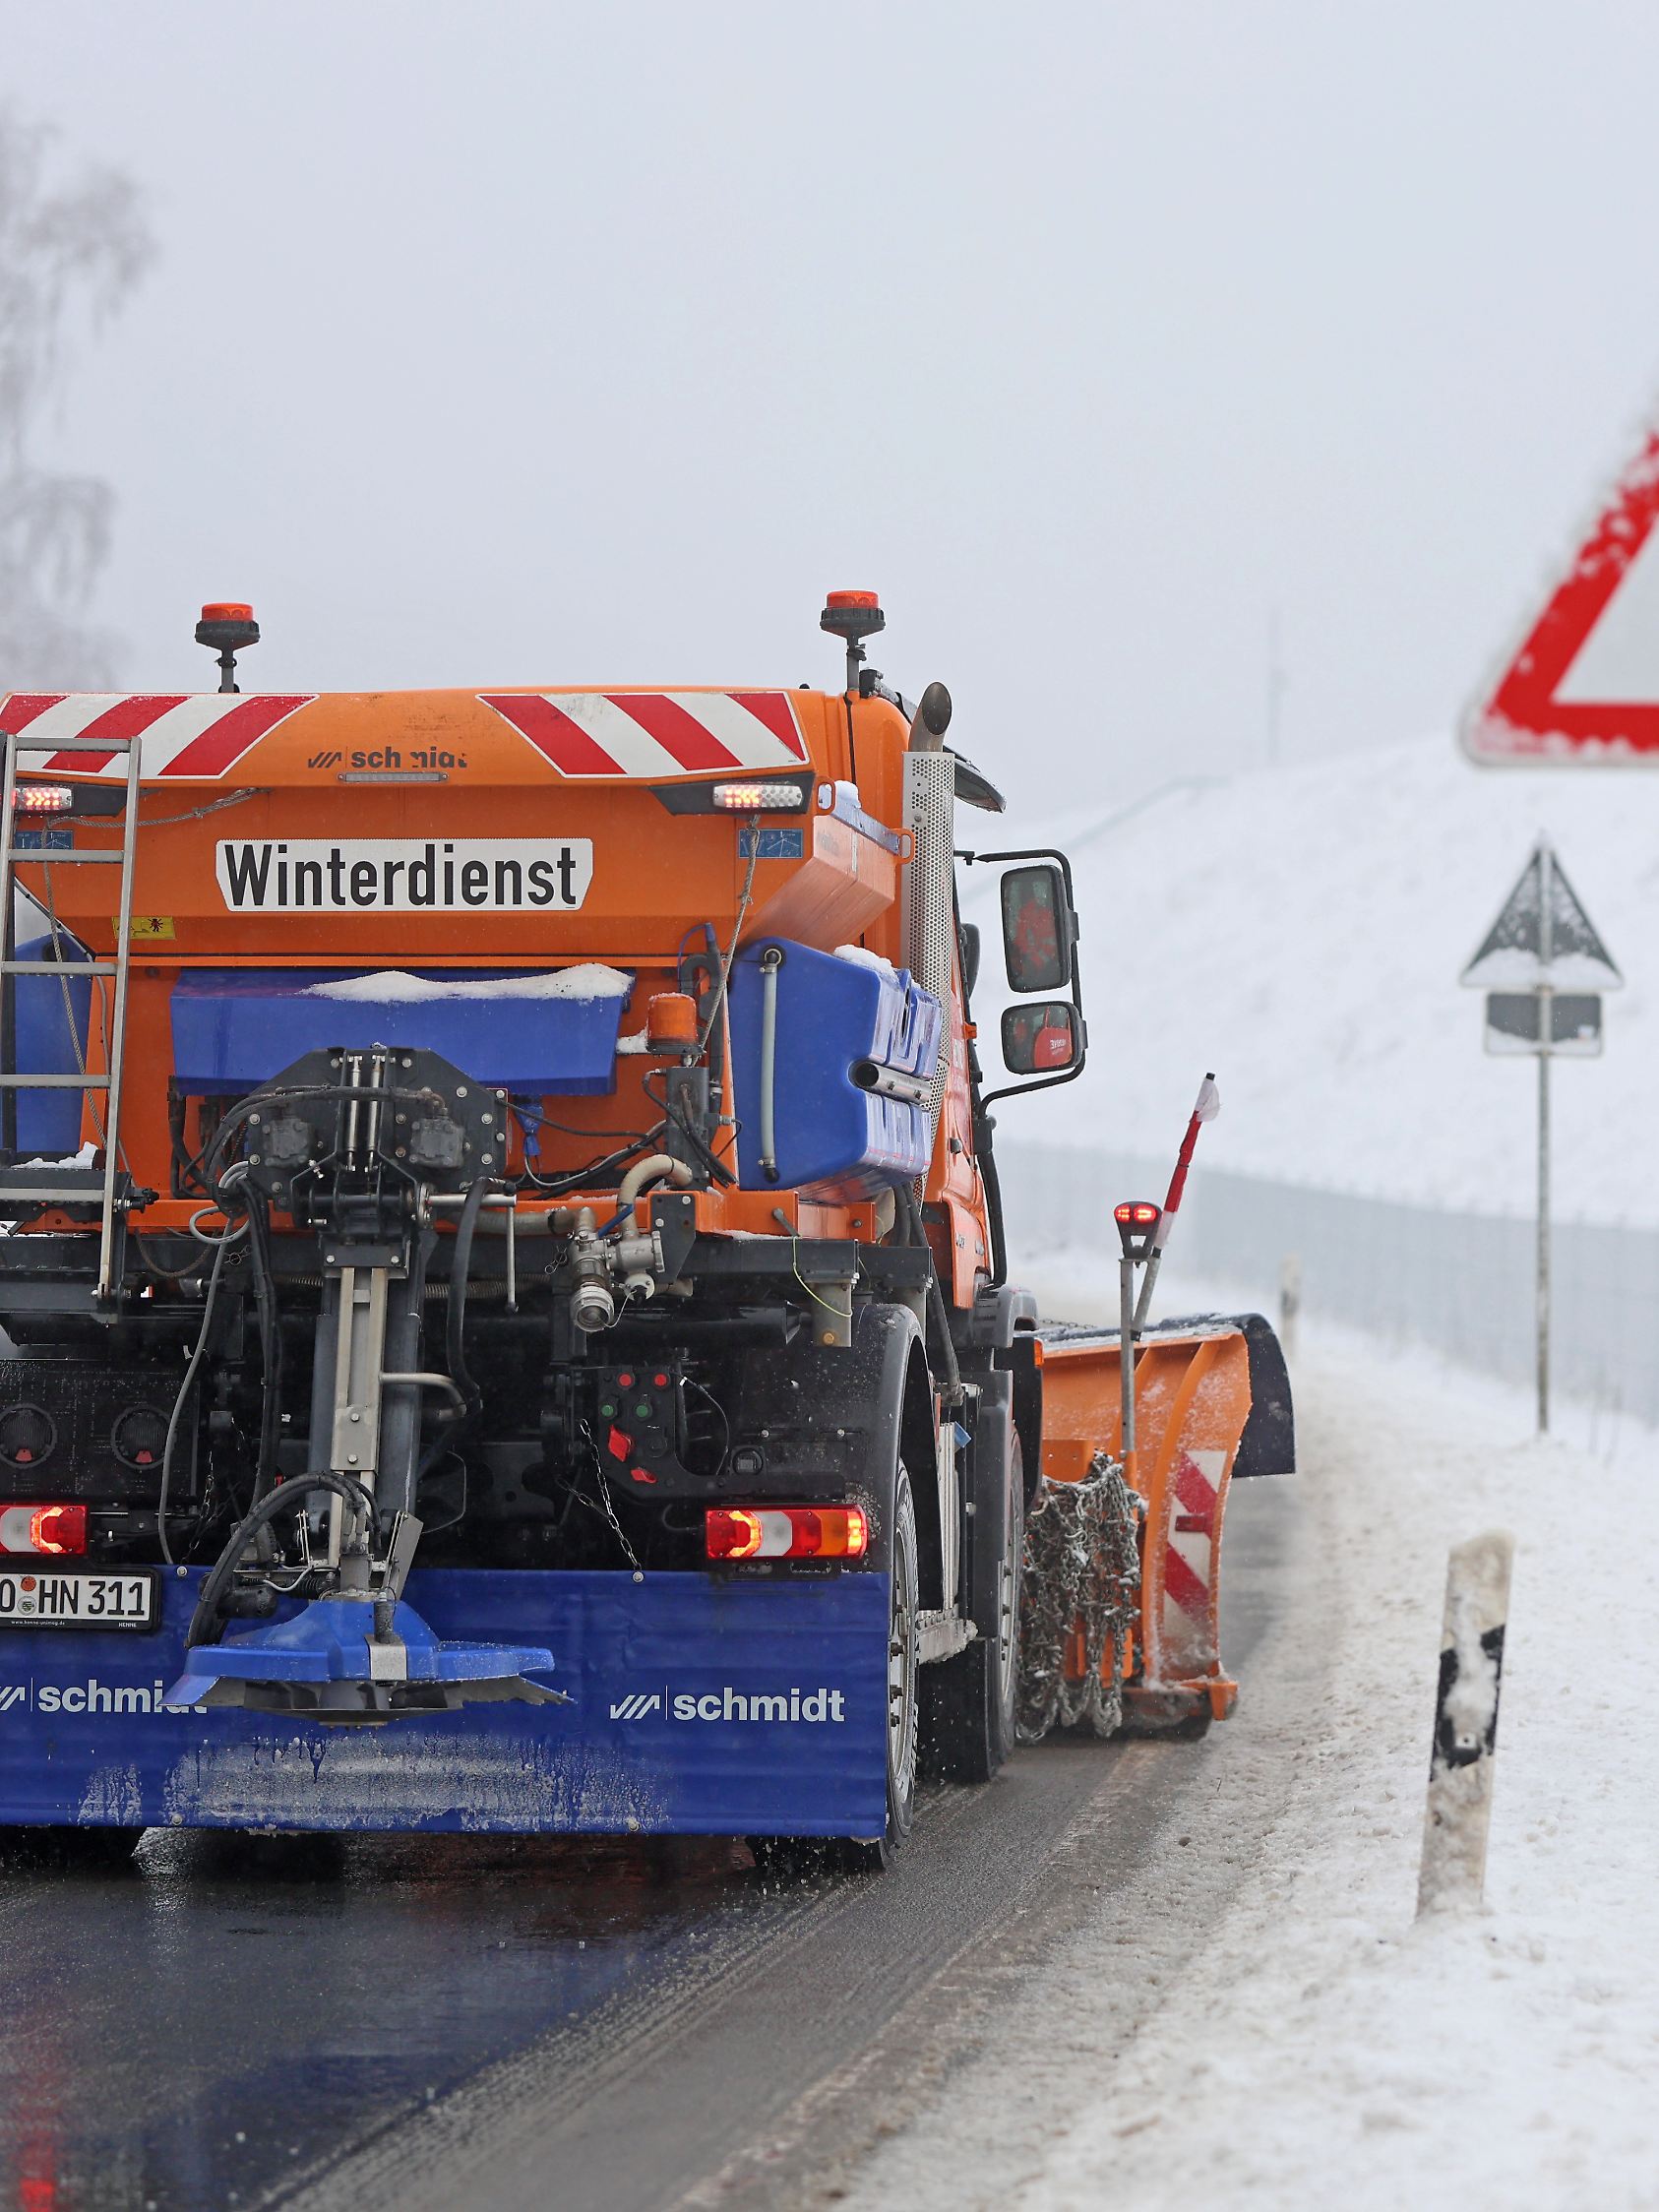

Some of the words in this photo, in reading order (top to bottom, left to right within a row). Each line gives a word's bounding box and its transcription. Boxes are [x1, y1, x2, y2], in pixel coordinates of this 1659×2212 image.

[224, 843, 577, 906] Winterdienst
[38, 1579, 79, 1615] HN
[88, 1580, 145, 1616] 311
[38, 1679, 208, 1714] schmi
[673, 1687, 845, 1722] schmidt
